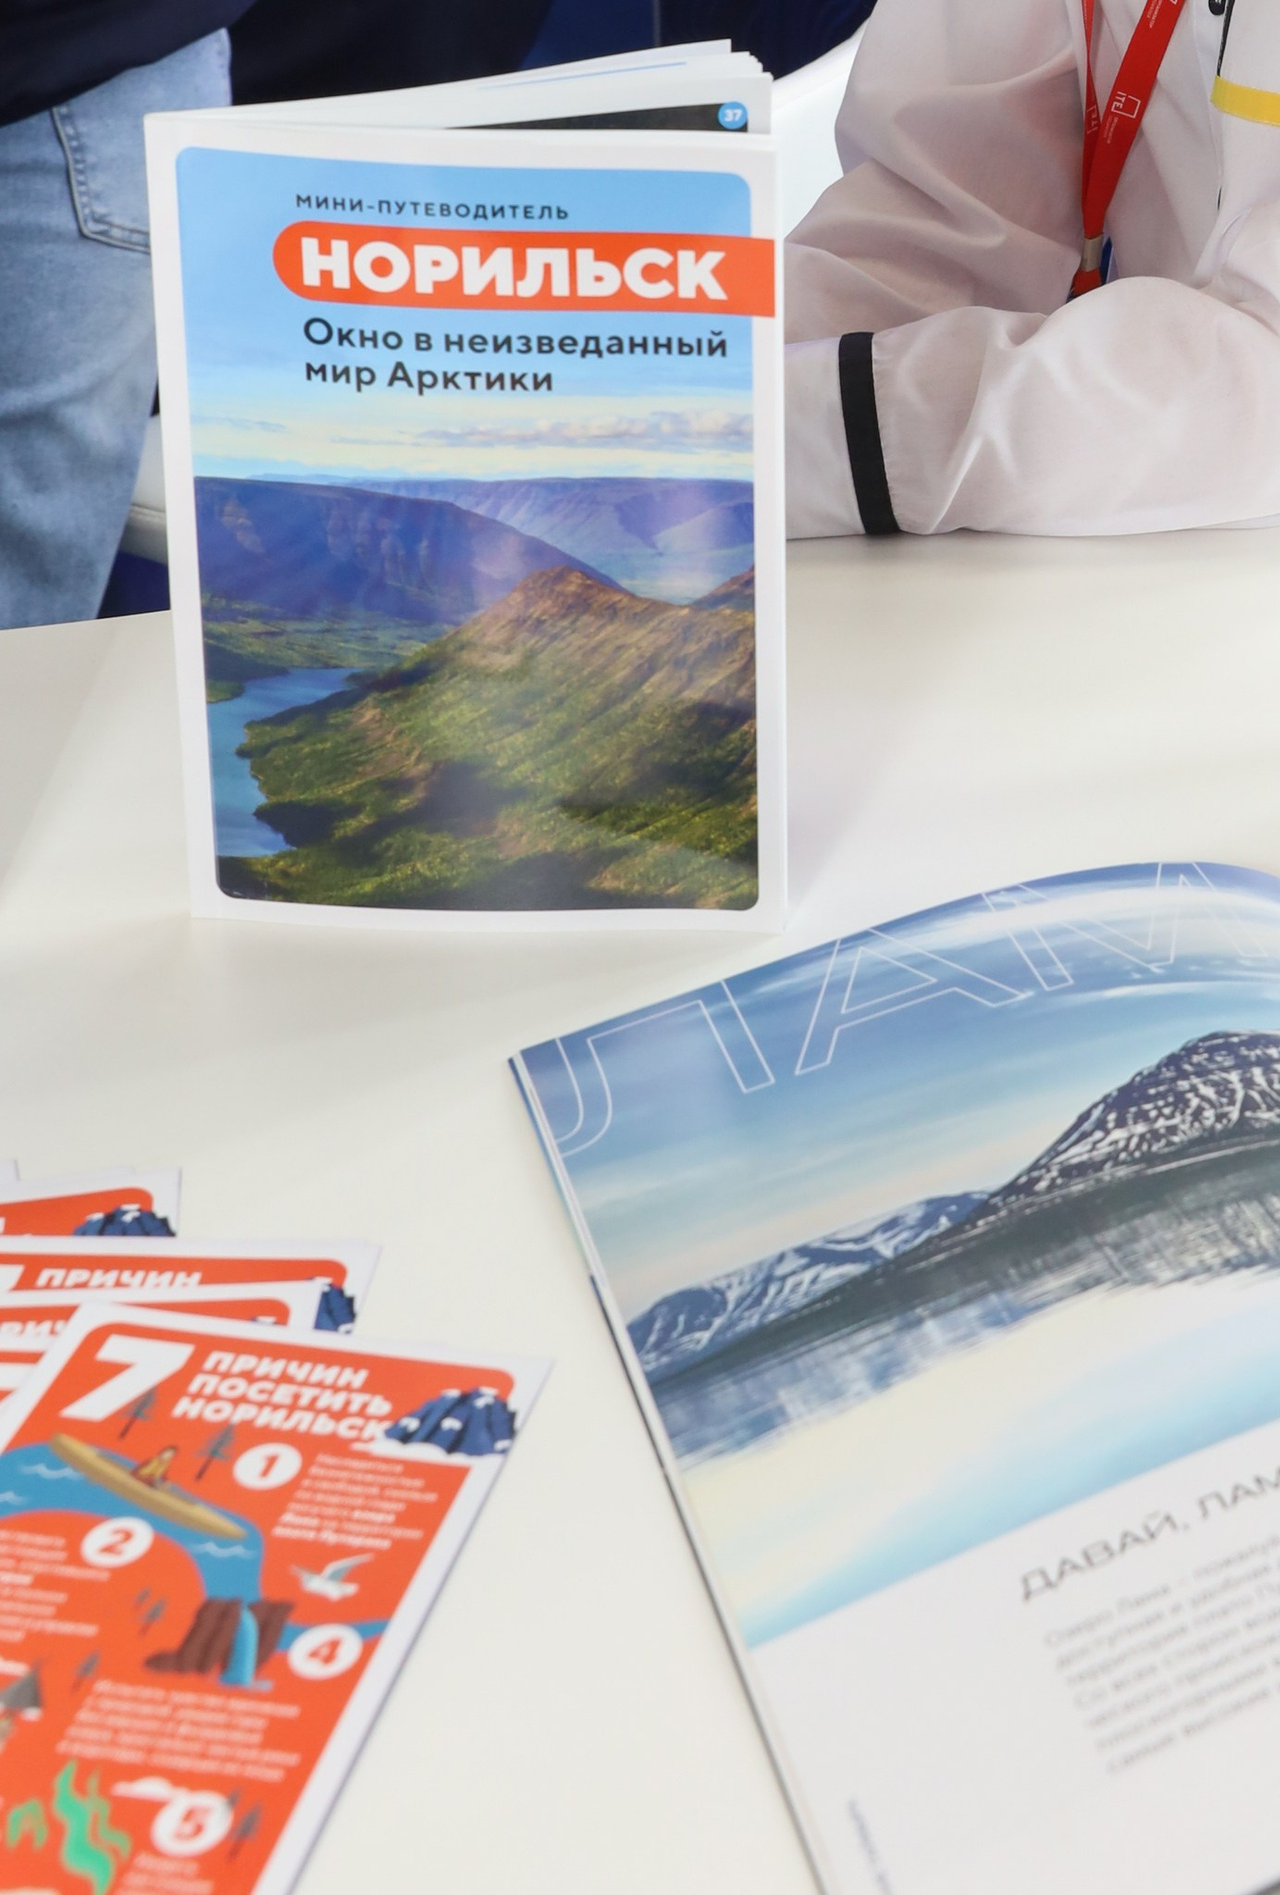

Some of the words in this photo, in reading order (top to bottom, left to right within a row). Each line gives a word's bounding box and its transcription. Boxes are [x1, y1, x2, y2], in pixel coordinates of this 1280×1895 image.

[724, 108, 743, 123] 37
[294, 192, 570, 221] МИНИ-ПУТЕВОДИТЕЛЬ
[299, 236, 729, 301] НОРИЛЬСК
[302, 315, 403, 353] Окно
[415, 331, 433, 353] в
[444, 327, 728, 360] неизведанный
[304, 360, 377, 394] мир
[387, 359, 554, 396] Арктики
[36, 1267, 202, 1289] ПРИЧИН
[59, 1333, 196, 1423] 7
[203, 1350, 369, 1389] ПРИЧИН
[187, 1373, 393, 1417] ПОСЕТИТЬ
[171, 1396, 392, 1441] НОРИЛЬСК
[259, 1455, 279, 1480] 1
[98, 1527, 135, 1557] 2
[1020, 1511, 1190, 1603] ДАВАЙ,
[307, 1637, 344, 1667] 4
[173, 1807, 207, 1841] 5
